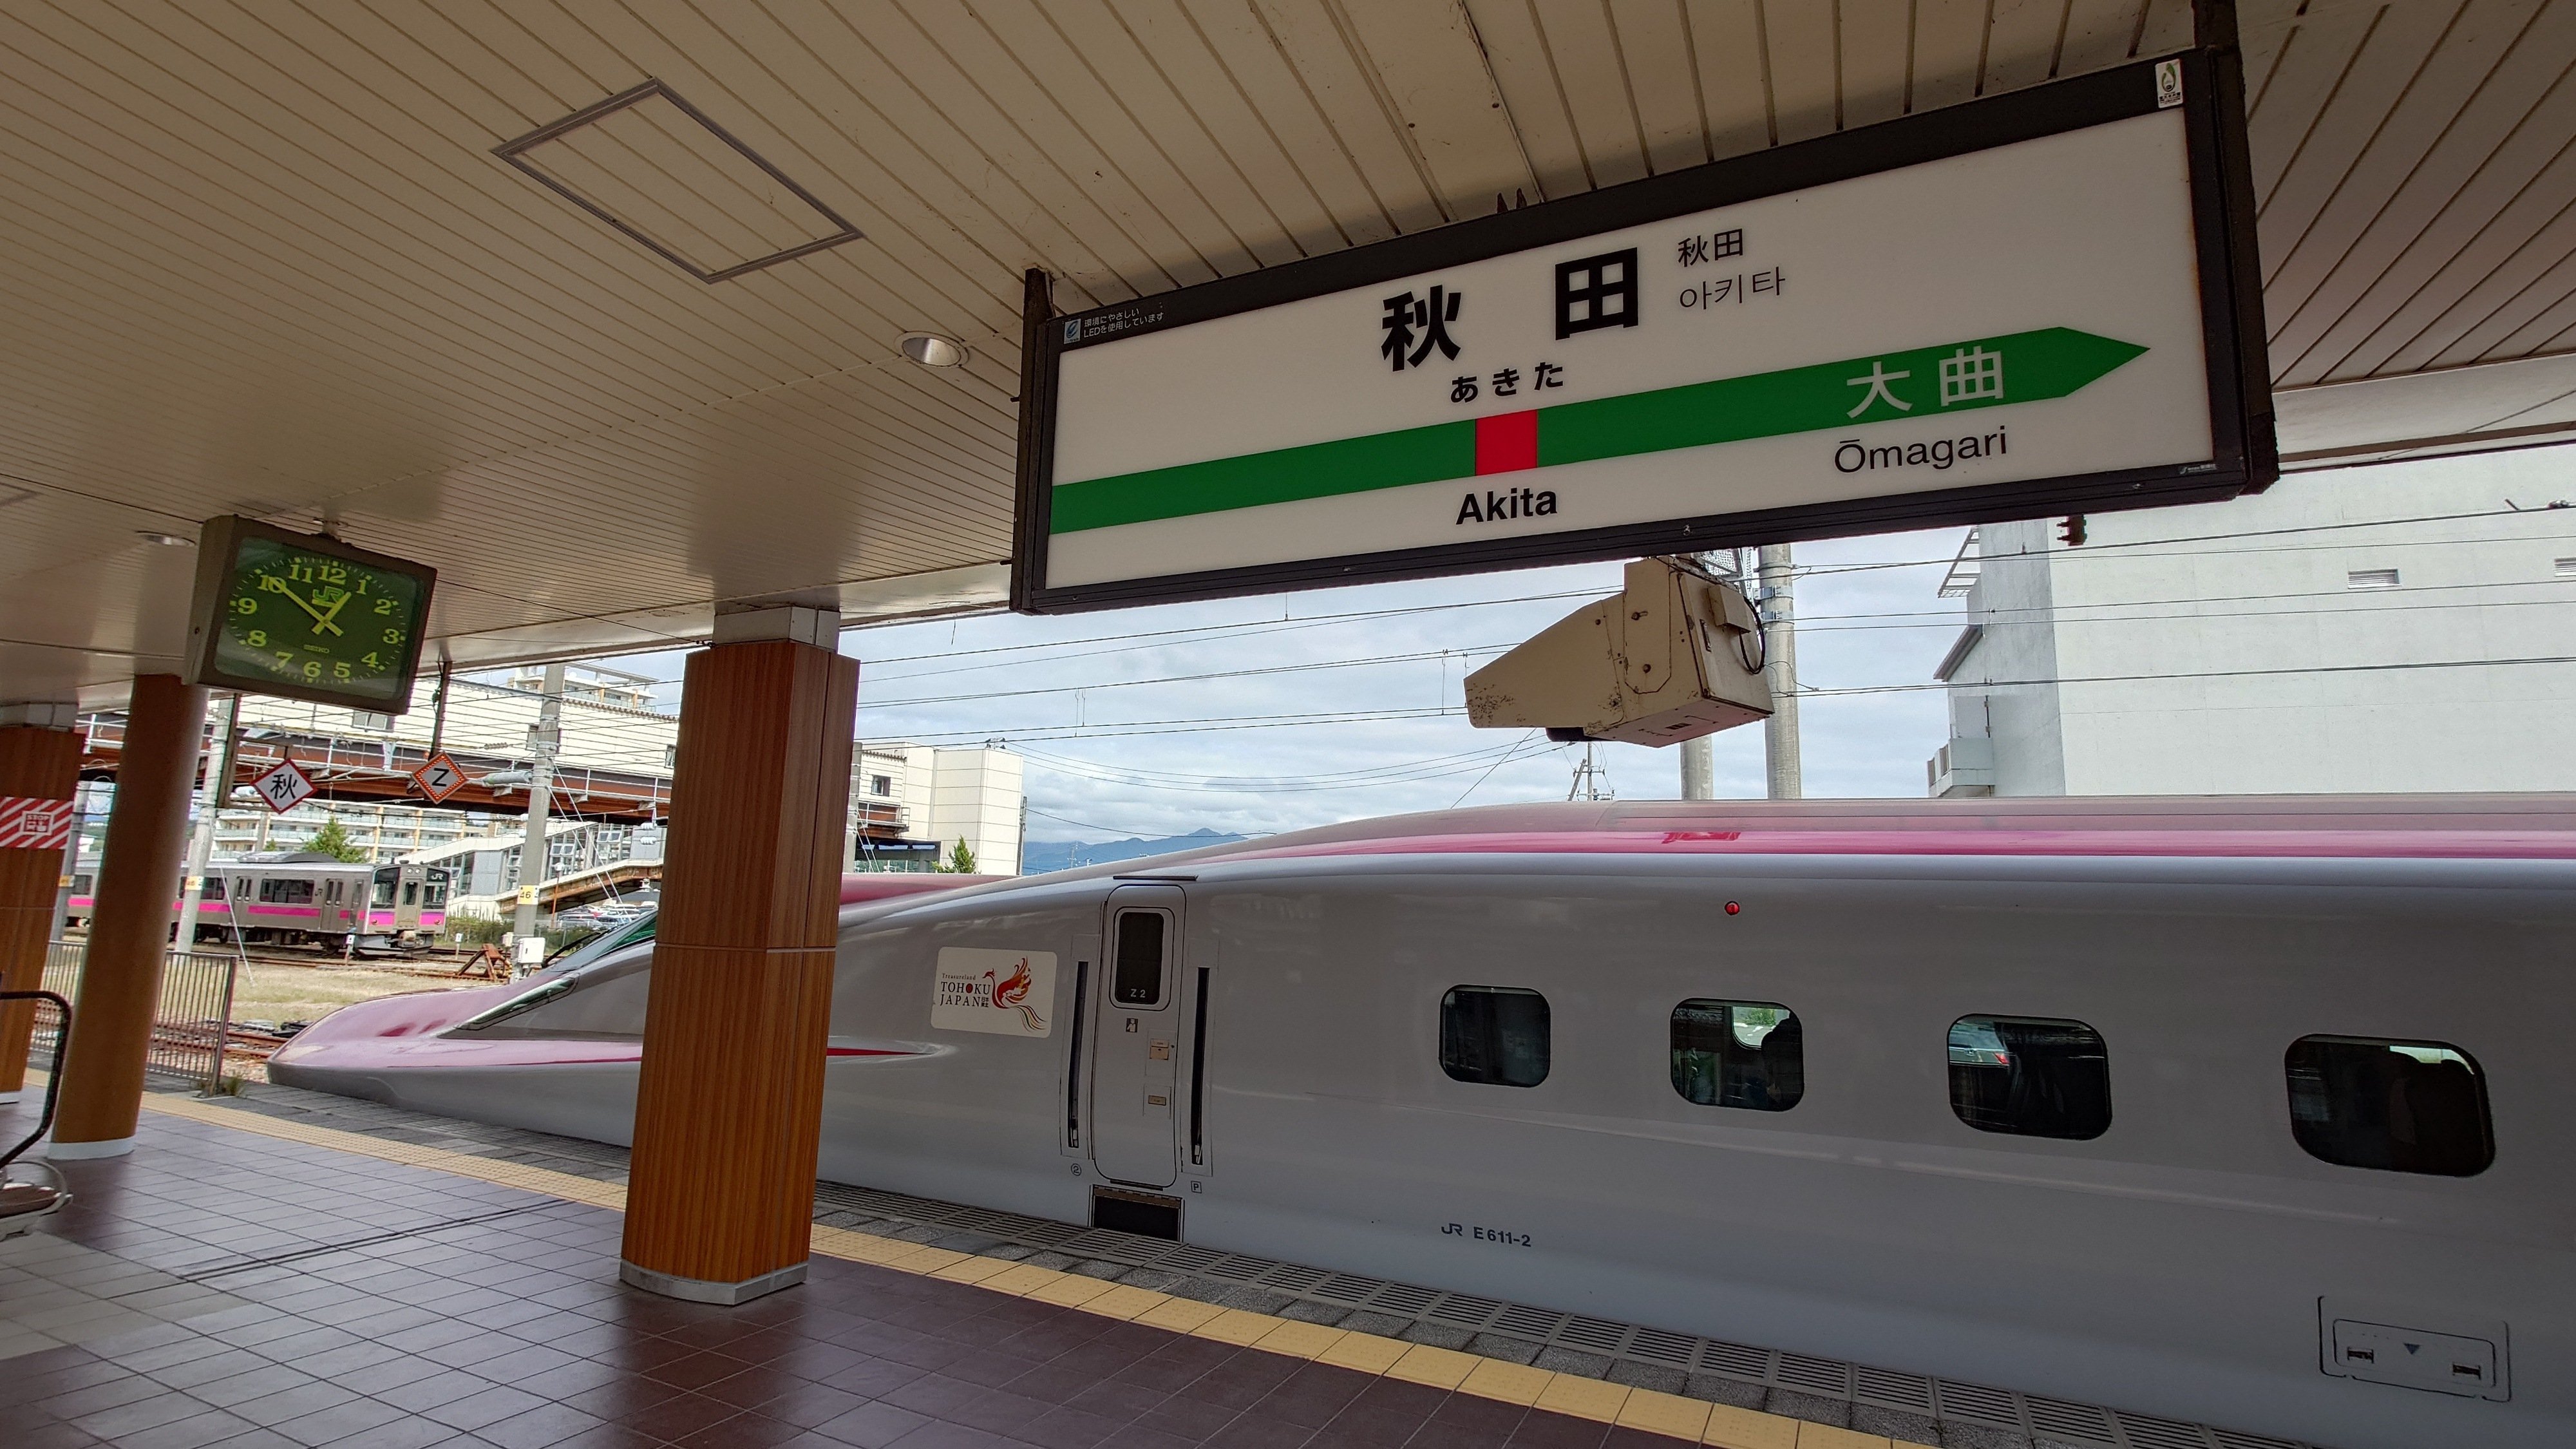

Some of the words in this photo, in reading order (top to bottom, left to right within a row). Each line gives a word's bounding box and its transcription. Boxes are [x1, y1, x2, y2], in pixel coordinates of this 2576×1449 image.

[1678, 228, 1744, 268] 秋田
[1678, 267, 1786, 310] 아키타
[1084, 308, 1140, 328] 環境にやさしい
[1381, 246, 1639, 372] 秋田
[1084, 312, 1164, 338] LEDを使用しています
[1450, 361, 1564, 404] あきた
[1846, 345, 2005, 419] 大曲
[1833, 425, 2008, 474] Ōmagari
[1455, 487, 1558, 526] Akita
[288, 564, 313, 583] 11
[317, 565, 346, 585] 12
[258, 574, 287, 594] 10
[355, 579, 367, 594] 1
[237, 598, 257, 615] 9
[374, 598, 392, 616] 2
[247, 629, 267, 648] 8
[383, 628, 399, 644] 3
[275, 650, 294, 668] 7
[361, 652, 379, 668] 4
[303, 661, 321, 678] 6
[333, 662, 351, 678] 5
[270, 773, 298, 800] 秋
[431, 767, 450, 787] Z
[941, 981, 991, 995] TOHOKU
[940, 994, 981, 1007] JAPAN
[1441, 1223, 1463, 1236] JR
[1473, 1226, 1531, 1247] E611-2
